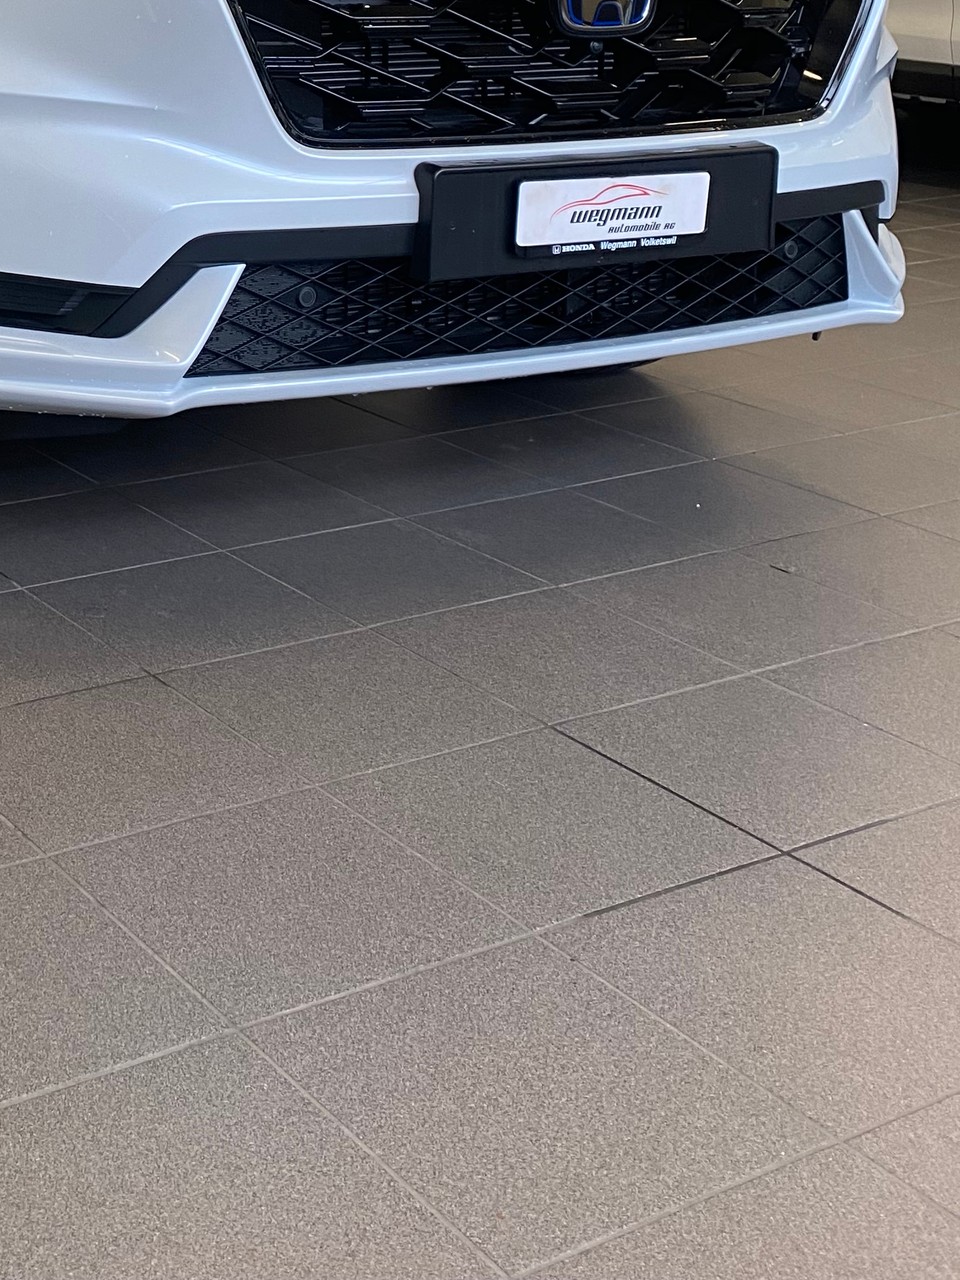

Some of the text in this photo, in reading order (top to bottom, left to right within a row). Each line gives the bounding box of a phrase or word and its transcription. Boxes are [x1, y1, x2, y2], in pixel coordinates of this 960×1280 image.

[570, 205, 663, 227] wegmann
[561, 243, 596, 253] HONDA
[600, 240, 637, 252] Wegmann
[640, 236, 678, 247] Volketswil
